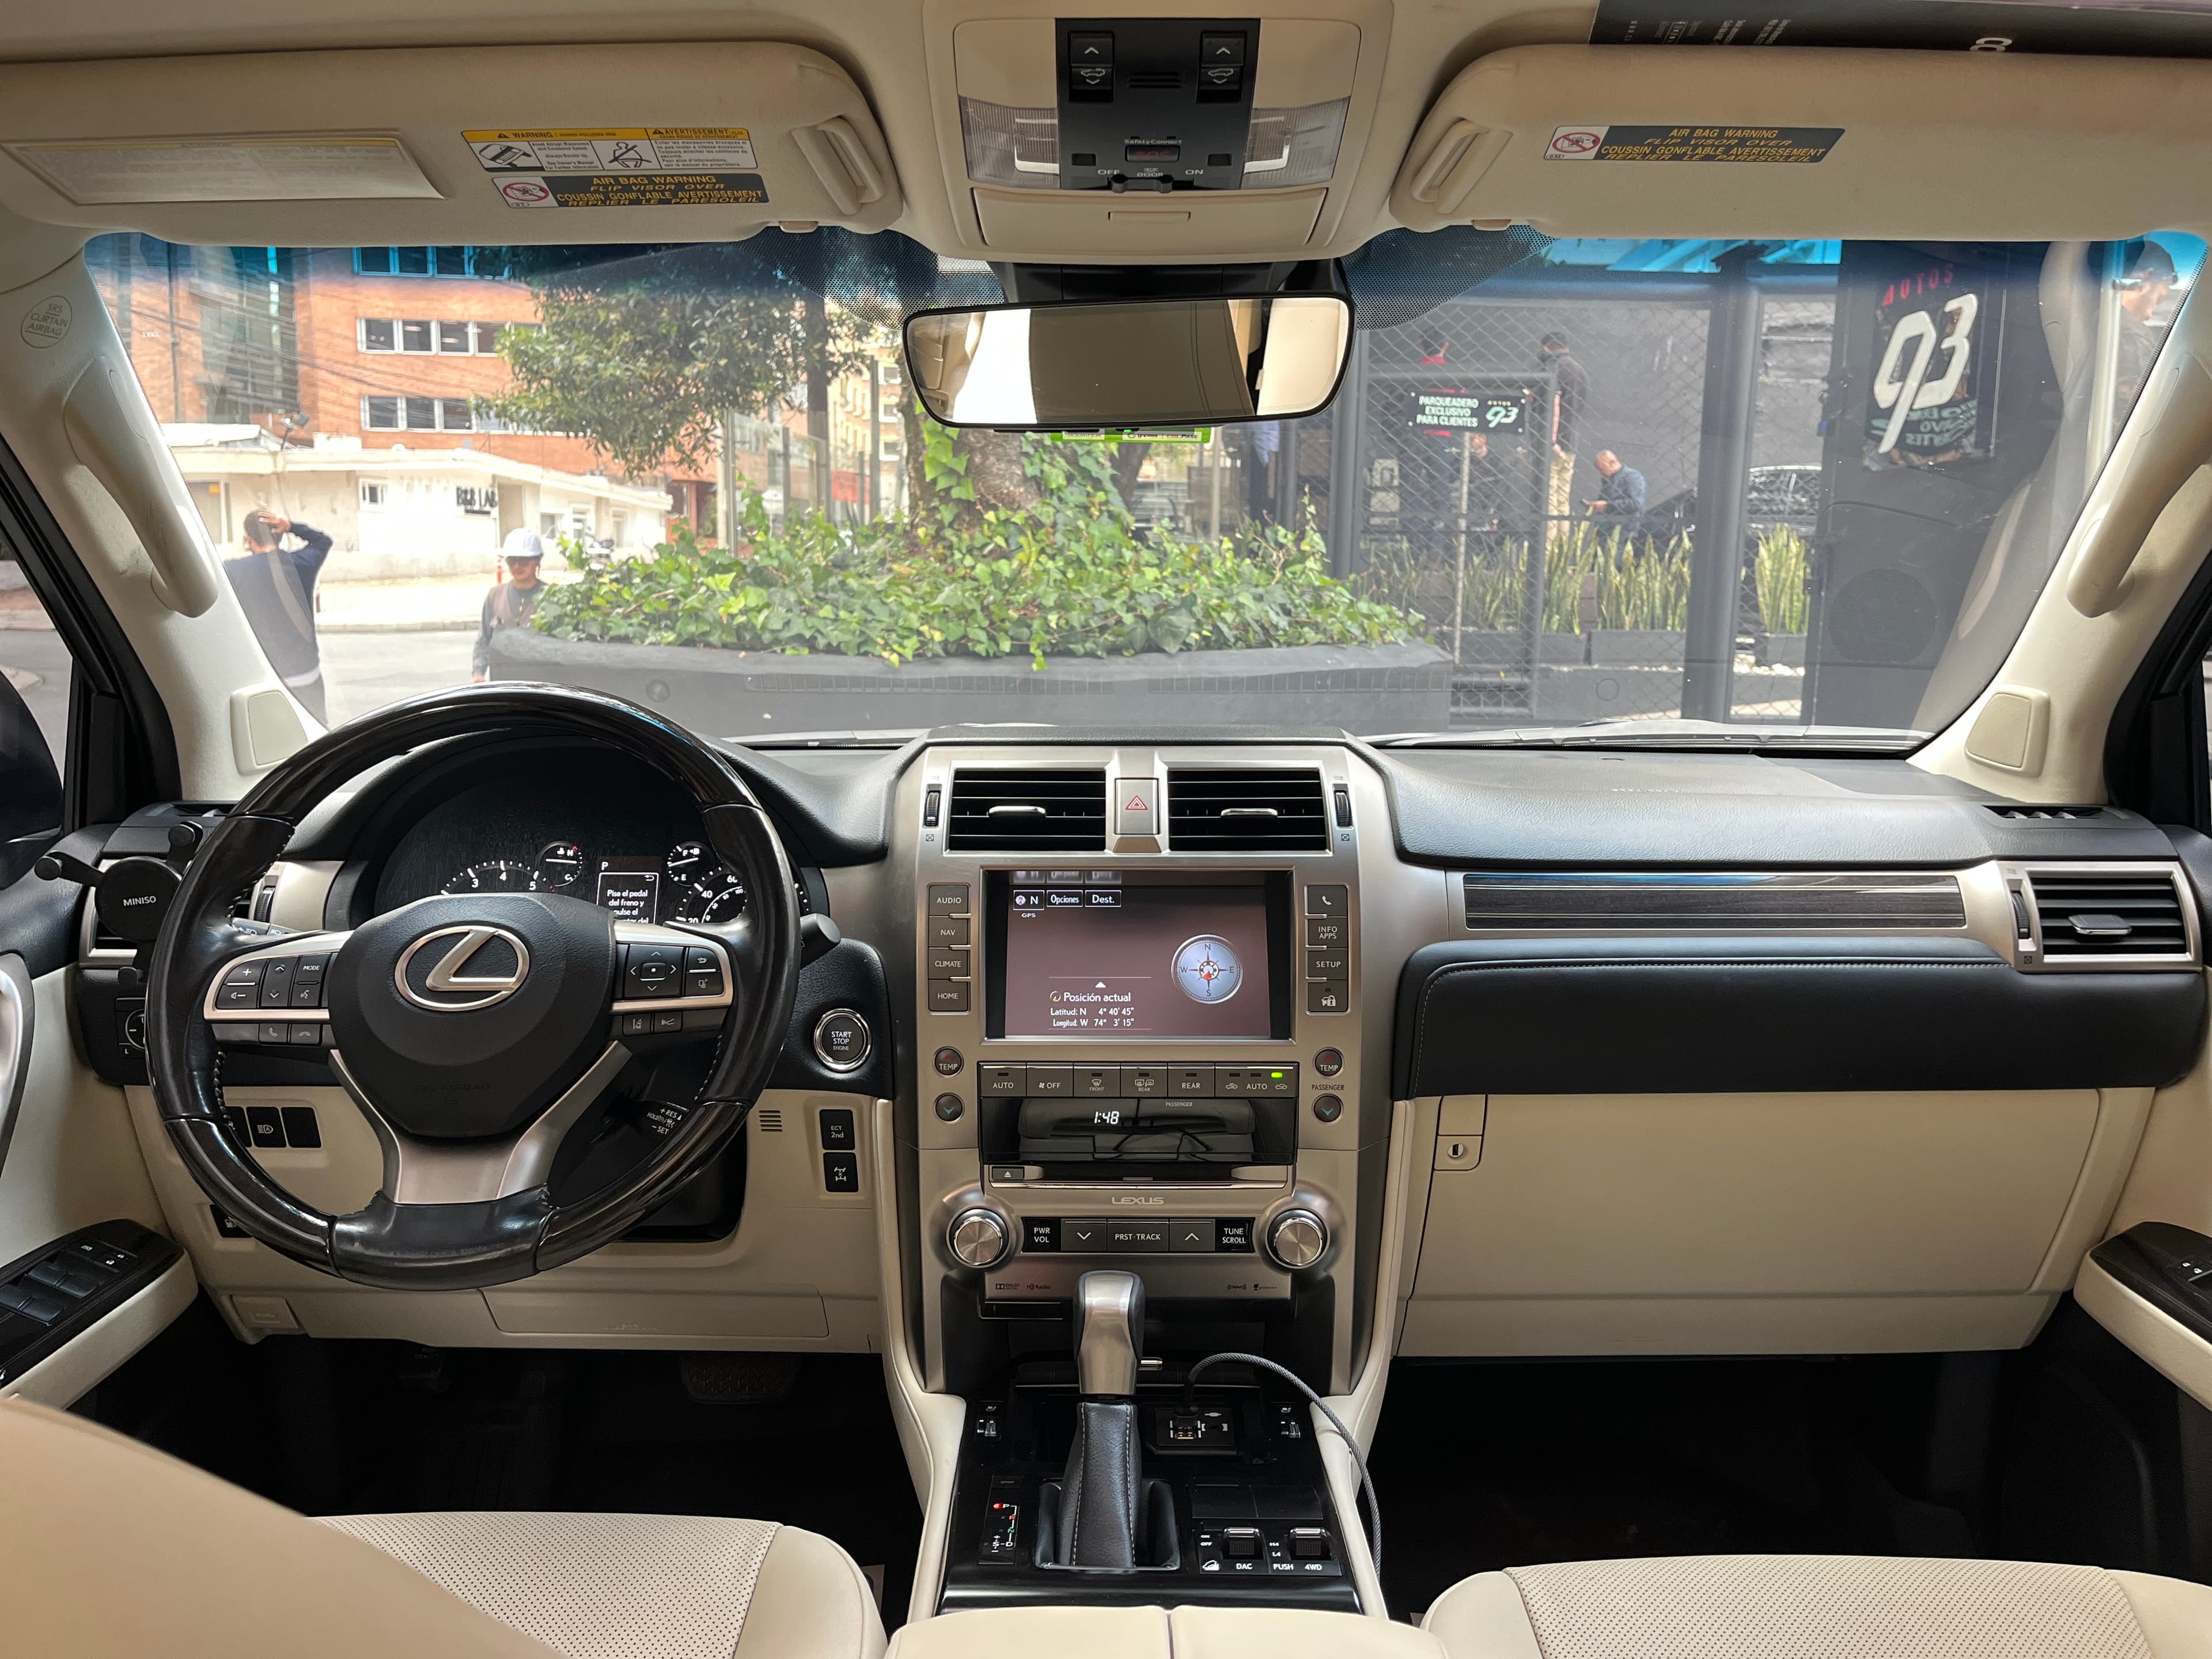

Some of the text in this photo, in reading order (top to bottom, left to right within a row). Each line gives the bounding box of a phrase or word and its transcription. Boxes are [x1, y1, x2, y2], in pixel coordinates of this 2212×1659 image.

[1669, 129, 1778, 138] AIR BAG WARNING
[1601, 146, 1825, 157] COUSSIN GONFLABLE AVERTISSEMENT
[1717, 155, 1813, 163] PARESOLEIL
[593, 176, 717, 185] AIR BAG WARNING
[557, 190, 762, 202] COUSSIN GONFLABLE AVERTISSEMENT
[671, 196, 760, 205] PARESOLEIL
[1881, 263, 1955, 307] AUTOS
[47, 303, 64, 314] SRS
[30, 312, 69, 328] CURTAIN
[27, 322, 62, 337] AIRBAG
[1873, 292, 1979, 454] 93
[1418, 395, 1479, 409] PARQUEADERO
[1424, 405, 1472, 417] EXCLUSIVO
[1416, 414, 1479, 428] PARA CLIENTES
[1485, 406, 1519, 429] 93
[601, 861, 609, 870] P
[499, 871, 507, 881] 4
[471, 878, 479, 888] 3
[529, 881, 536, 891] 5
[607, 889, 621, 897] Pise
[629, 889, 648, 899] pedal
[701, 890, 713, 899] 40
[123, 895, 157, 907] MINISO
[1030, 894, 1115, 906] N Opciones Dest.
[1063, 991, 1131, 1002] Posición actual
[1050, 1007, 1134, 1016] Latitud: N 4° 40' 45"
[1053, 1018, 1134, 1028] Longitud: W 74° 3' 15"
[647, 1112, 660, 1122] HOLD
[665, 1109, 679, 1119] RES
[1094, 1111, 1120, 1125] 1:48
[657, 1126, 670, 1135] SET
[1111, 1196, 1165, 1205] LEXUS
